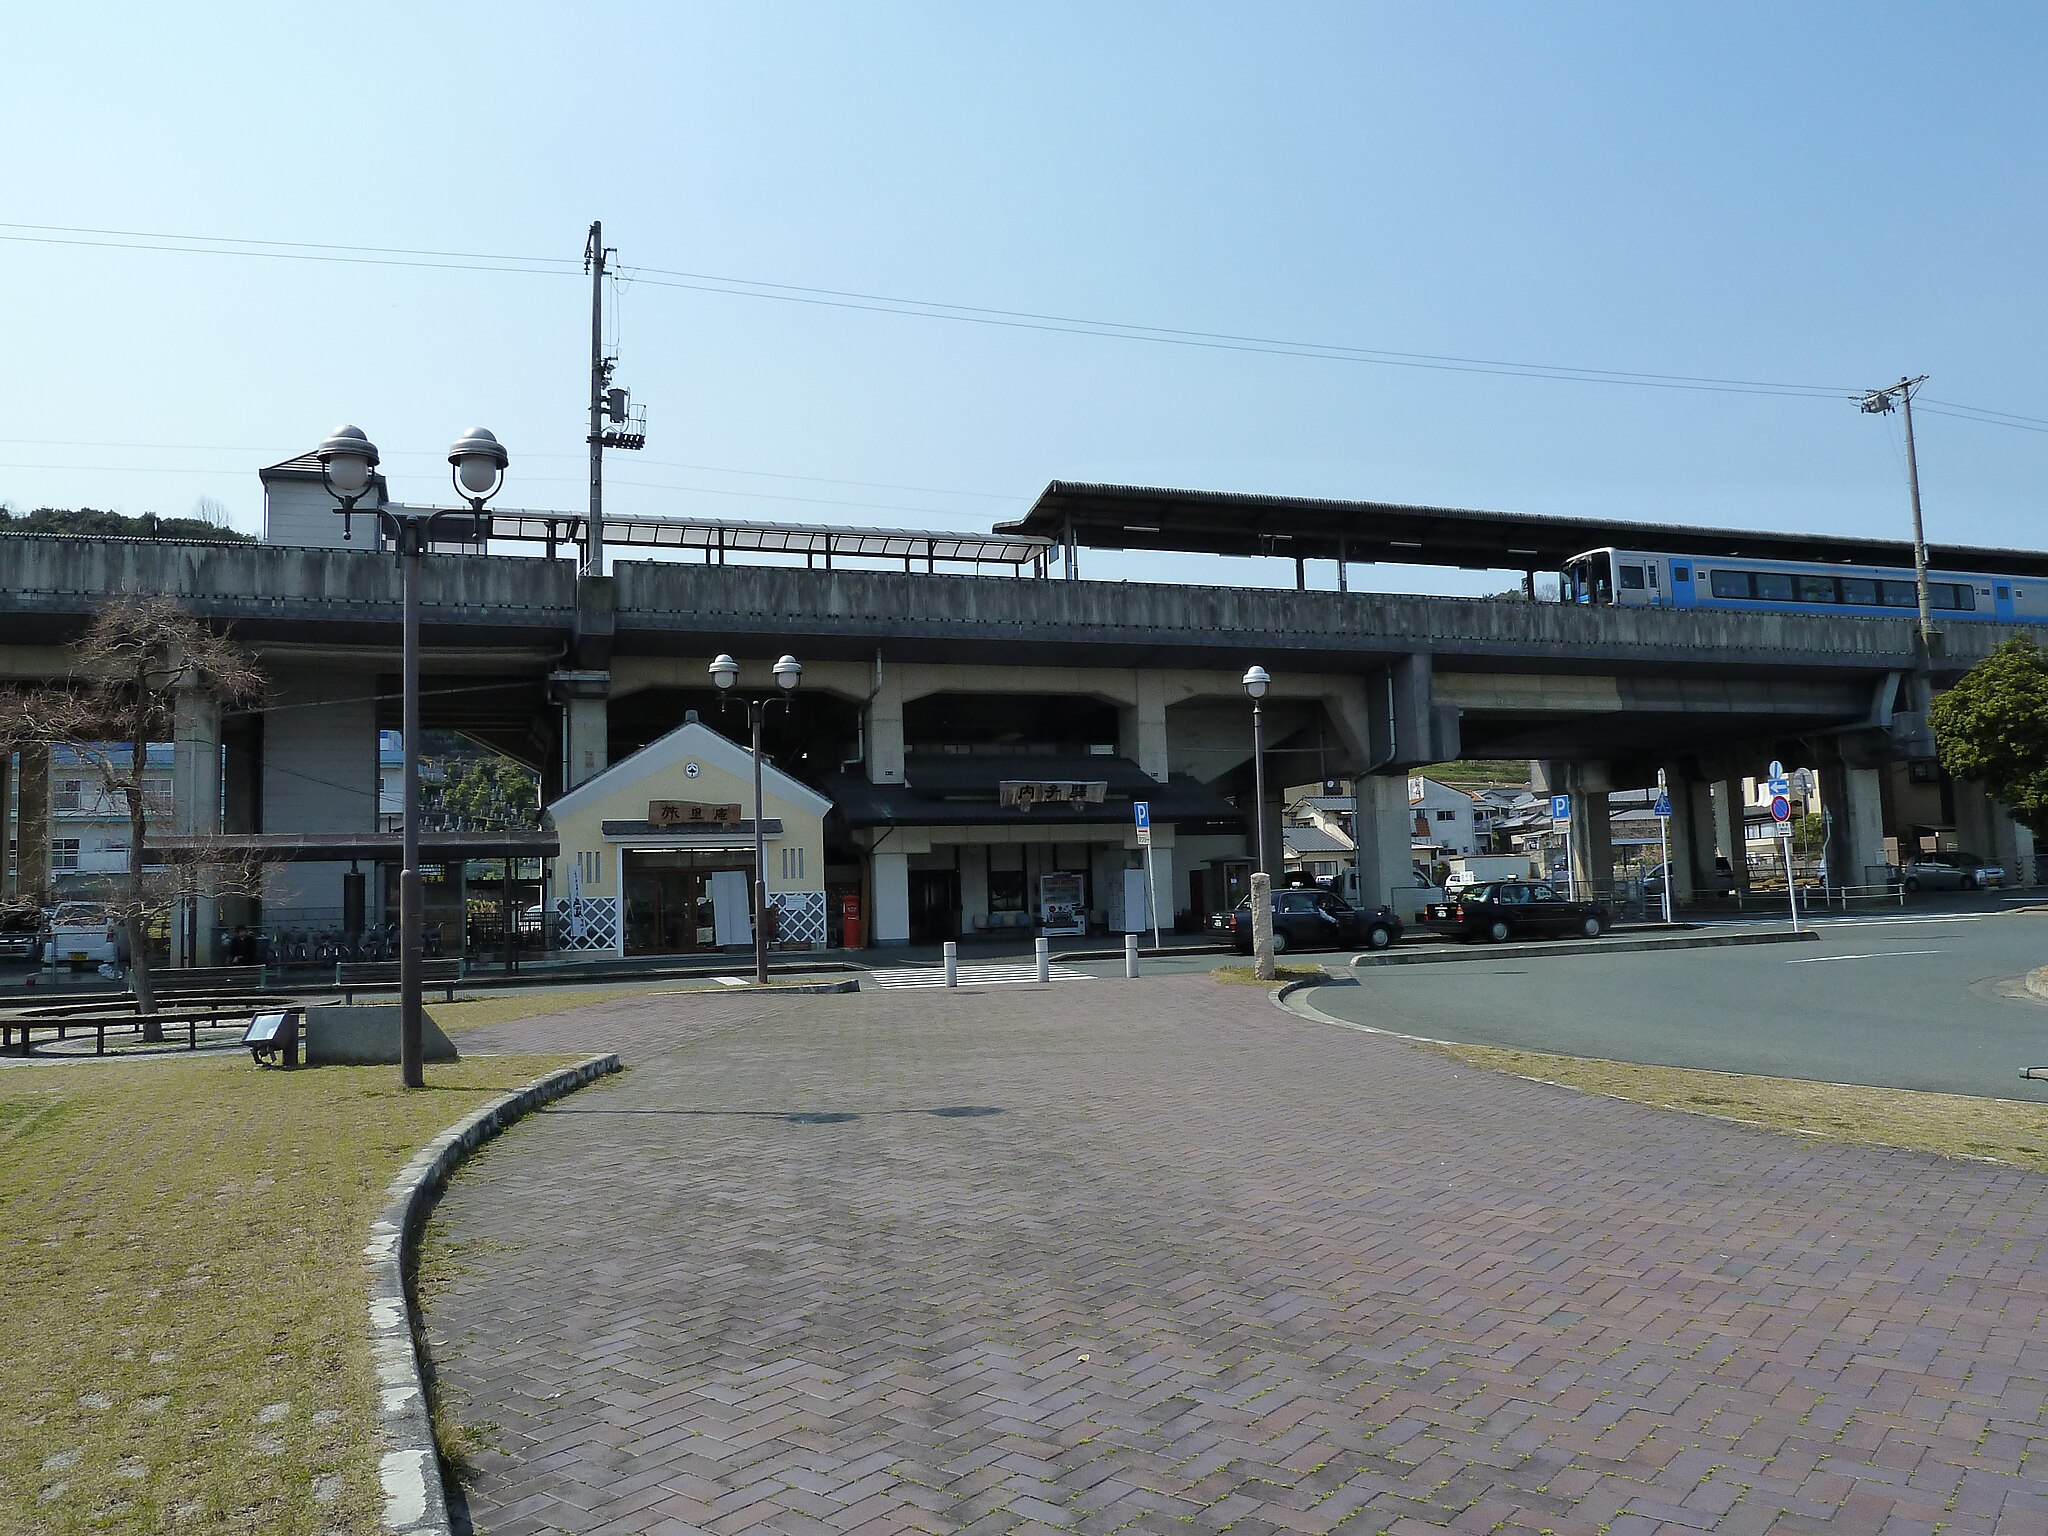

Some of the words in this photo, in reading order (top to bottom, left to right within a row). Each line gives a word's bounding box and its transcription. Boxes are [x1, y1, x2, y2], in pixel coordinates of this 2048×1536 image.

[661, 805, 729, 821] 旅里庵
[1137, 804, 1146, 826] P
[1555, 798, 1566, 817] P
